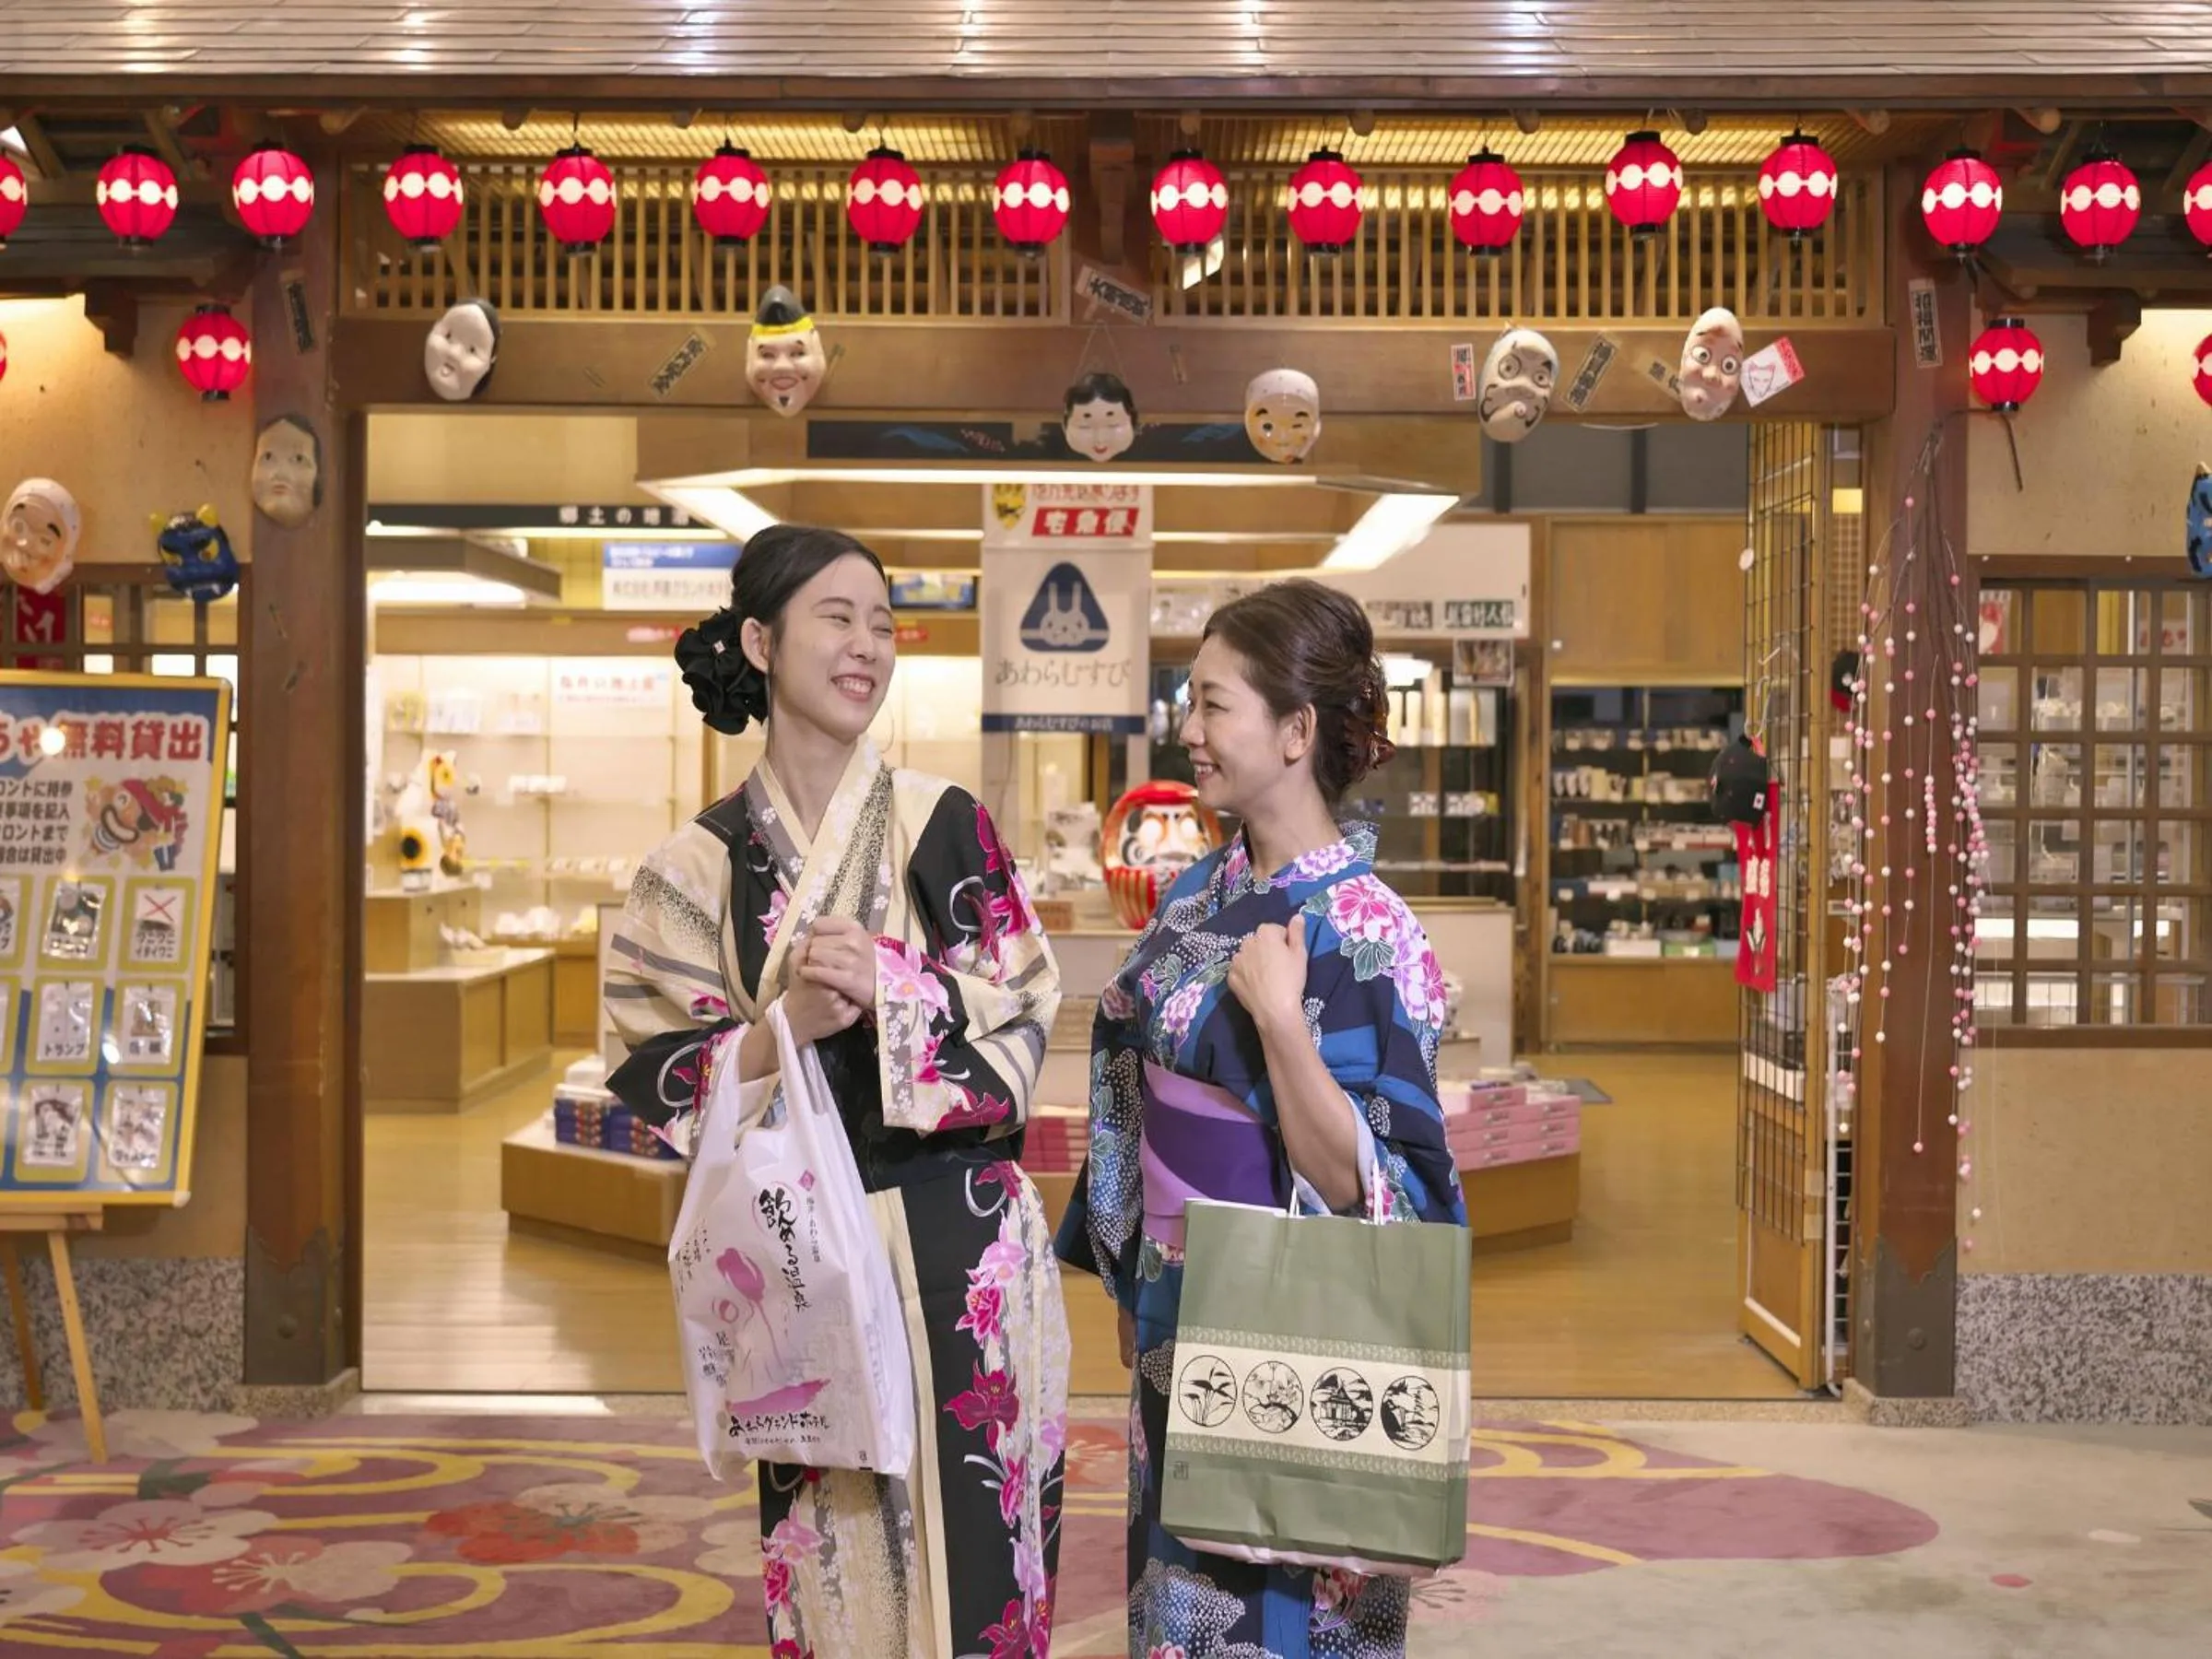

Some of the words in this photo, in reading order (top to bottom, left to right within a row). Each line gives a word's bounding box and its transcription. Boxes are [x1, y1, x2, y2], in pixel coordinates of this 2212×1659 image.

[995, 658, 1132, 687] あわらむすび
[0, 802, 69, 820] 事項を記入
